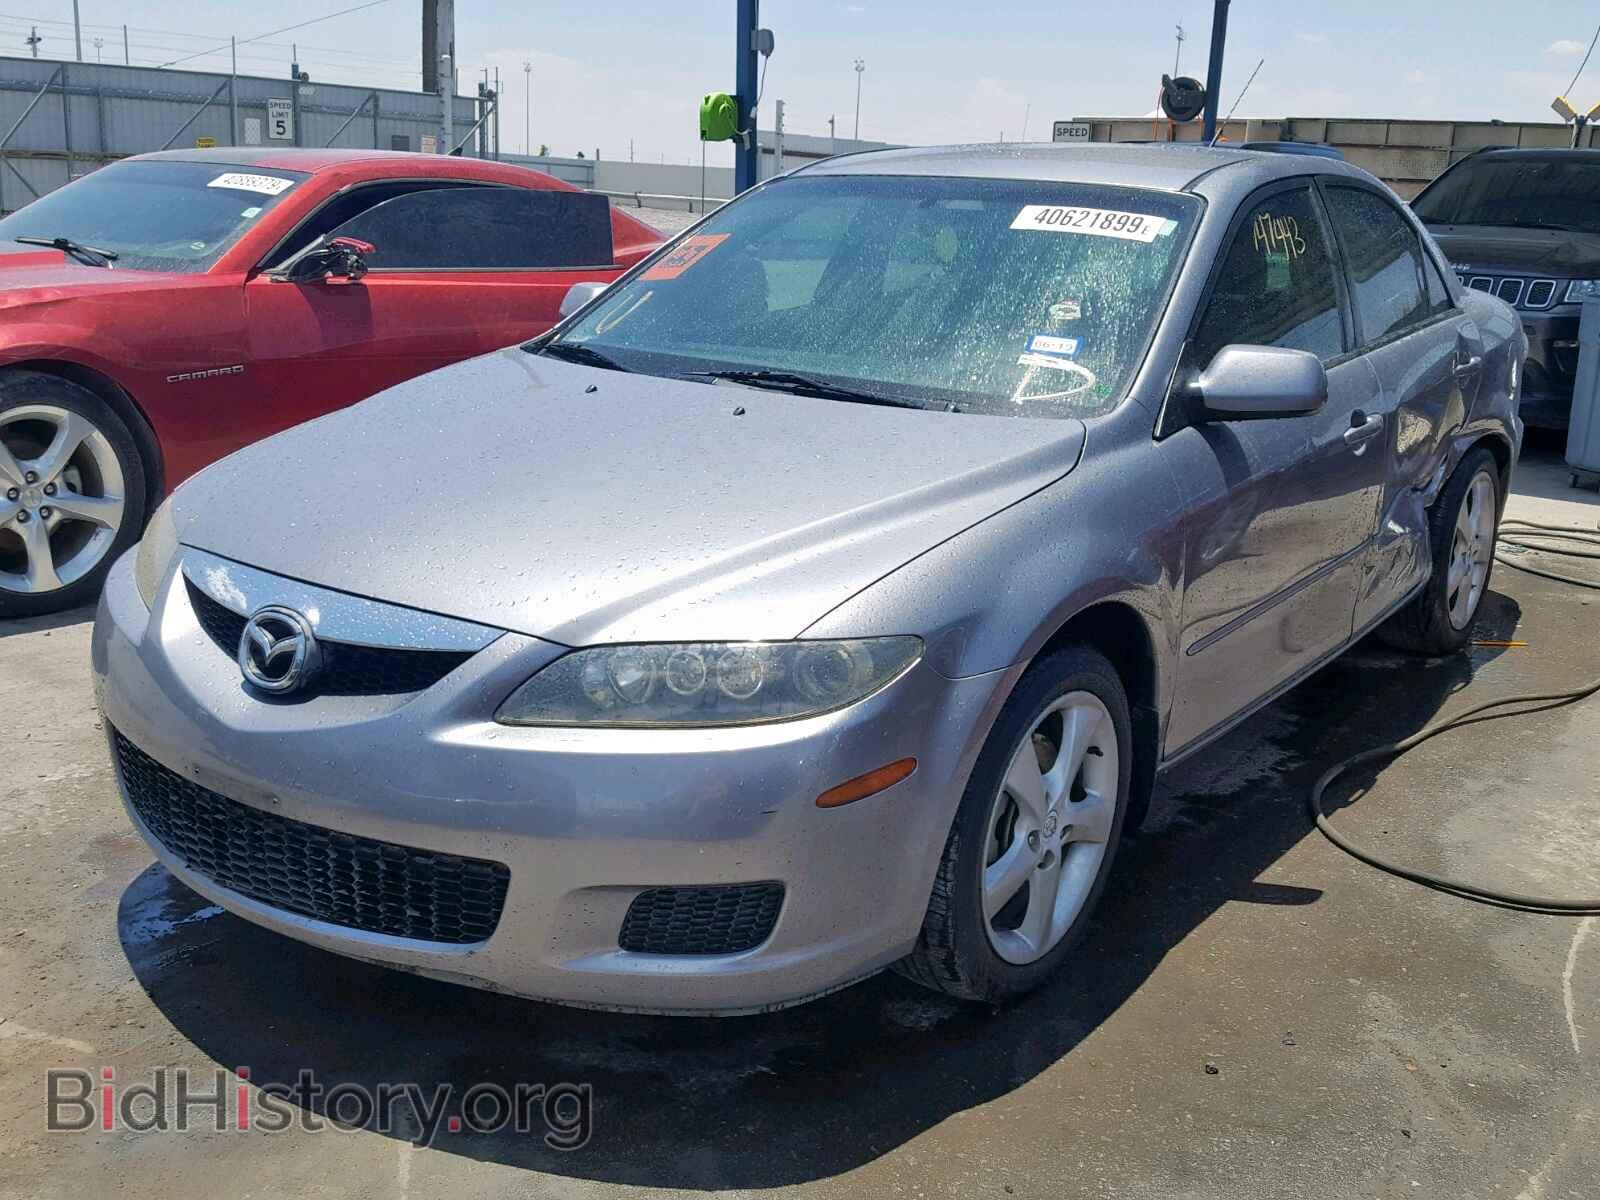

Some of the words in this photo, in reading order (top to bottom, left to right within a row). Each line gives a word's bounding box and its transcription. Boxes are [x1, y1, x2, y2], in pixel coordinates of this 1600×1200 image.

[269, 101, 292, 110] SPEED
[271, 111, 290, 119] LIMIT
[275, 120, 287, 136] 5
[1055, 127, 1089, 137] SPEED
[166, 364, 244, 383] CAMARO
